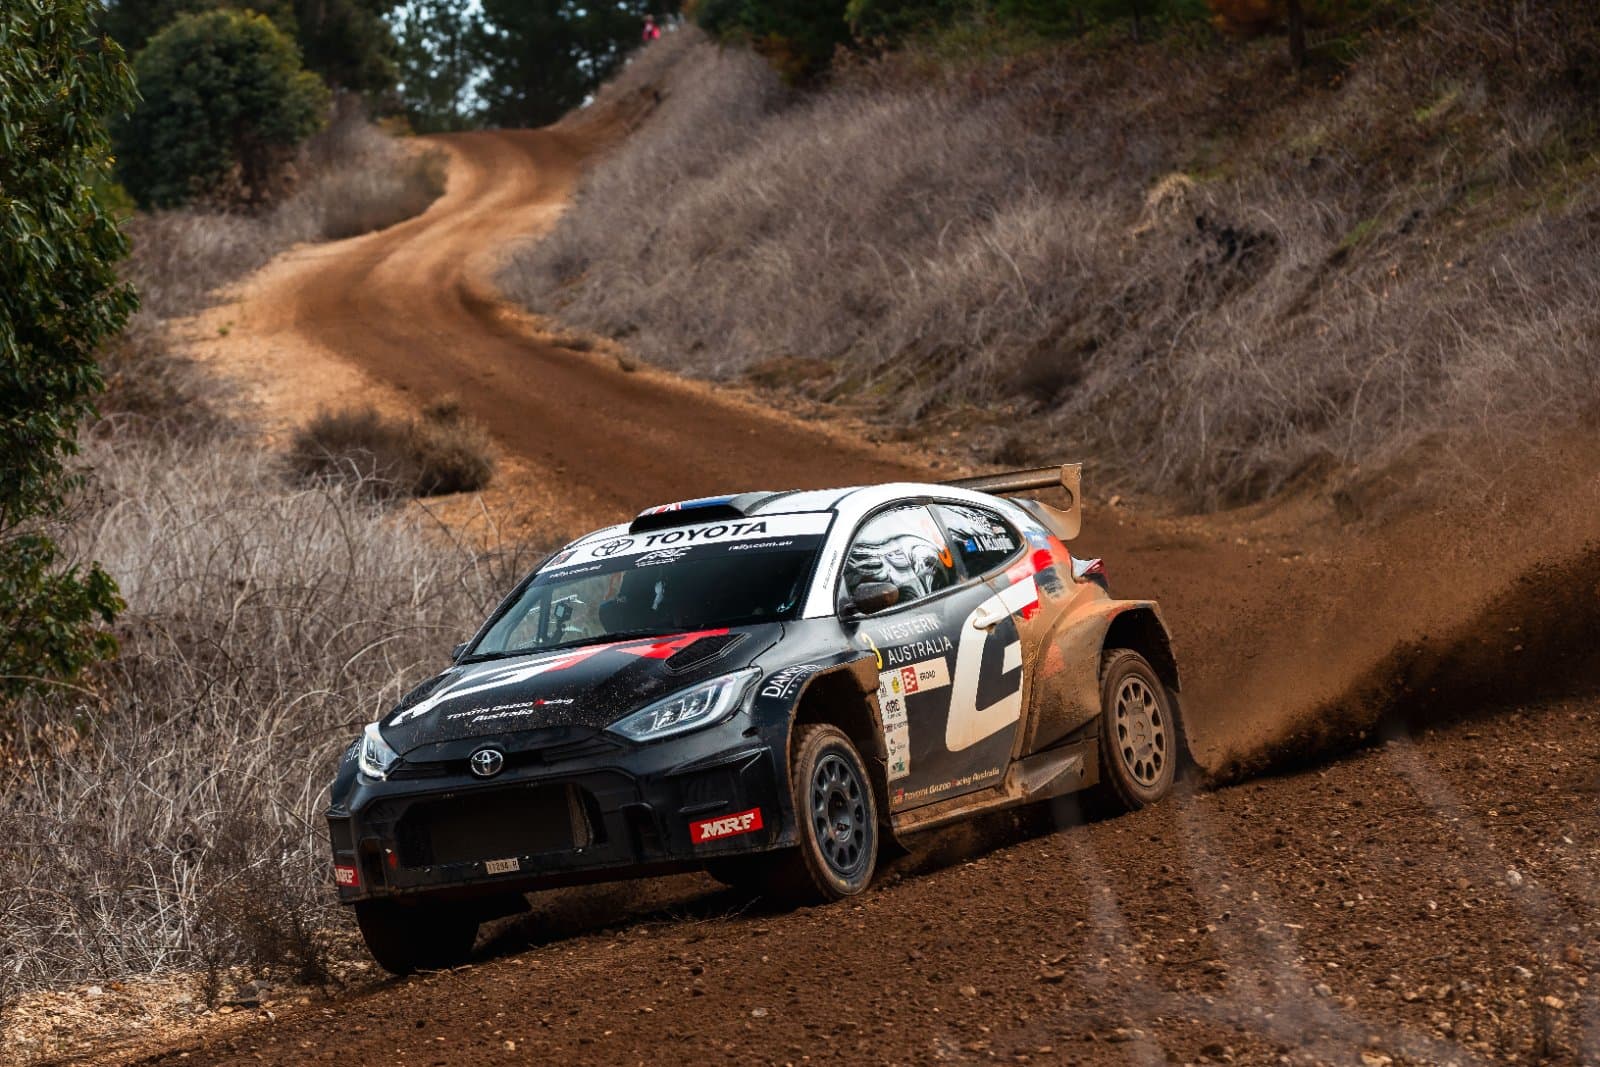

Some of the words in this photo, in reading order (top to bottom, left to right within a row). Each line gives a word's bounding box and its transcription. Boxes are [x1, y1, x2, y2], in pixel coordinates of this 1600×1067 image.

[645, 521, 767, 547] TOYOTA
[879, 615, 940, 641] WESTERN
[888, 636, 953, 665] AUSTRALIA
[447, 707, 490, 720] TOYOTA
[471, 708, 534, 723] Australia
[972, 767, 1000, 782] Australia
[700, 812, 755, 840] MRF
